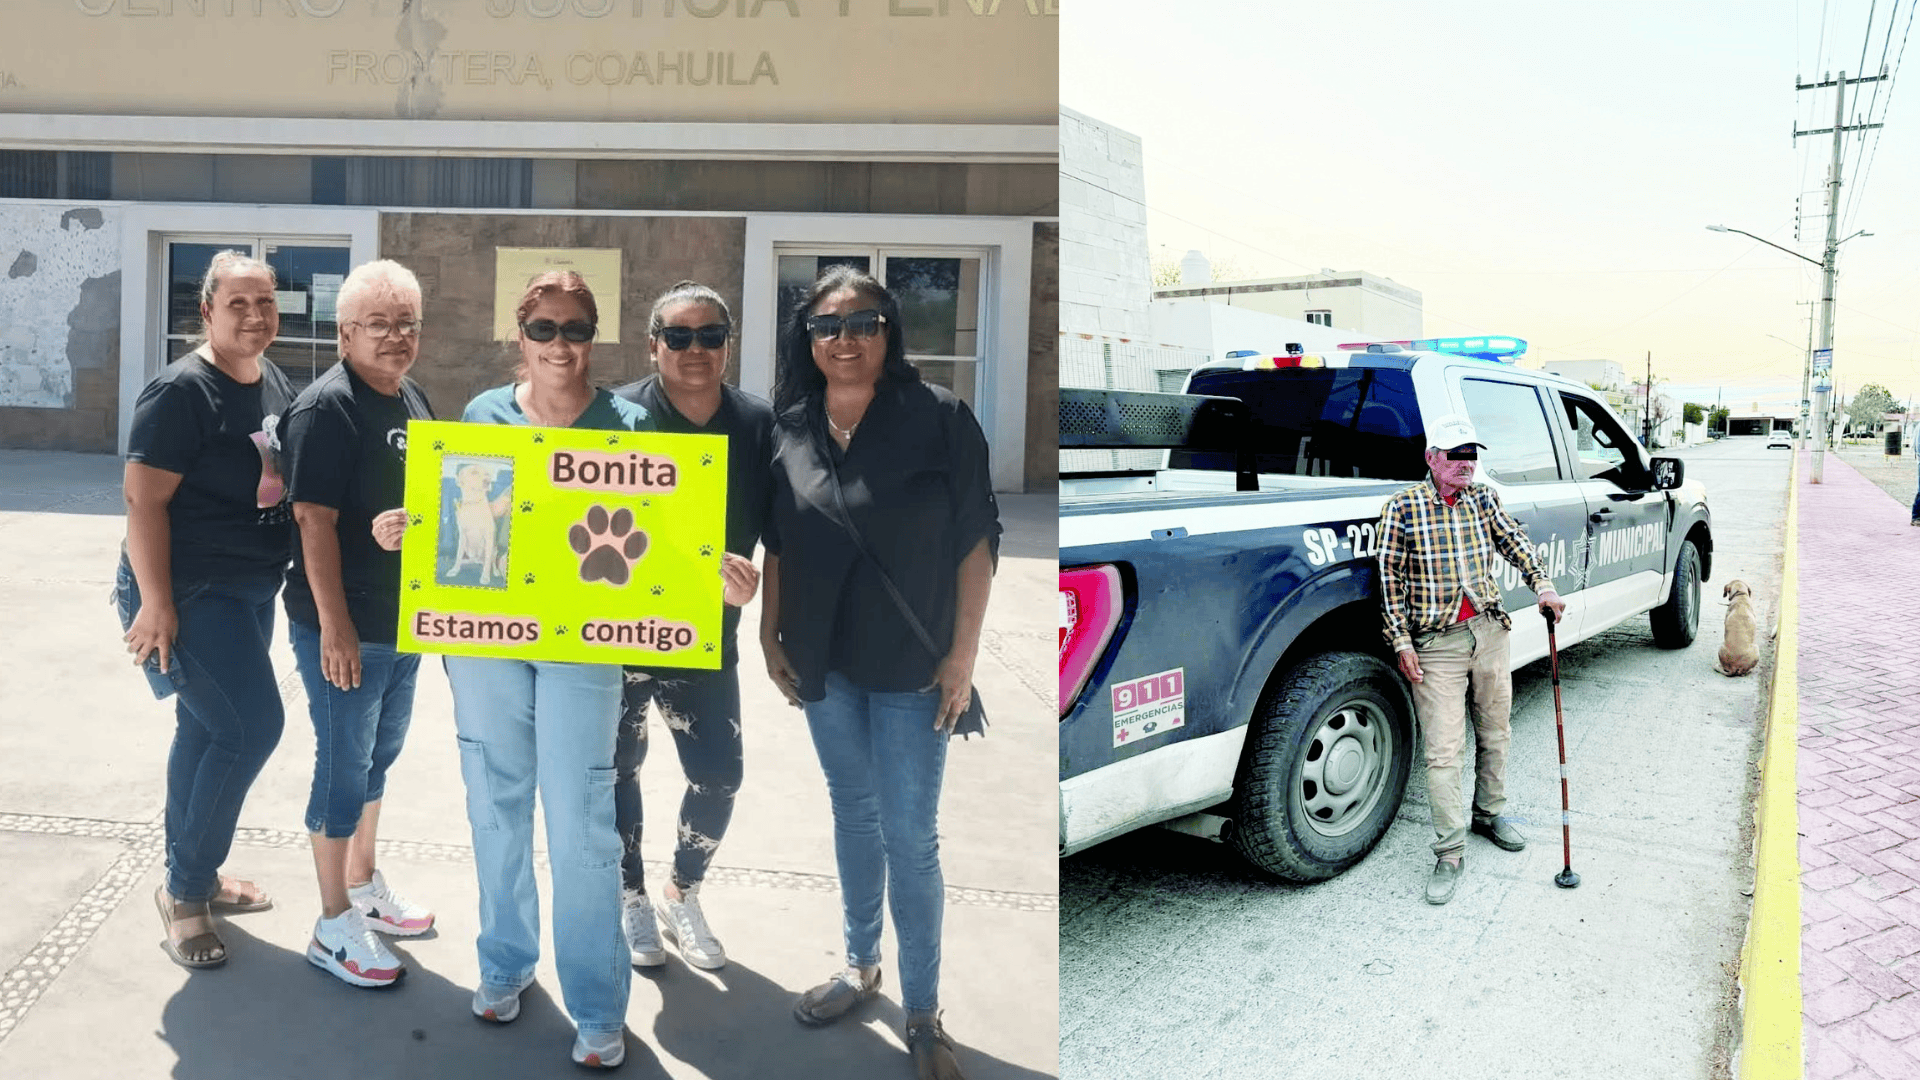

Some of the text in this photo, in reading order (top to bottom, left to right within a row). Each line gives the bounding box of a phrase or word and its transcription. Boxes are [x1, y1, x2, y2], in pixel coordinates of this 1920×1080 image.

[327, 50, 780, 91] FROTERA, COAHUILA
[552, 452, 678, 487] Bonita
[1598, 521, 1665, 567] MUNICIPAL
[415, 611, 693, 651] Estamos contigo
[1118, 676, 1176, 708] 911
[1114, 701, 1184, 728] EMERGENCIAS
